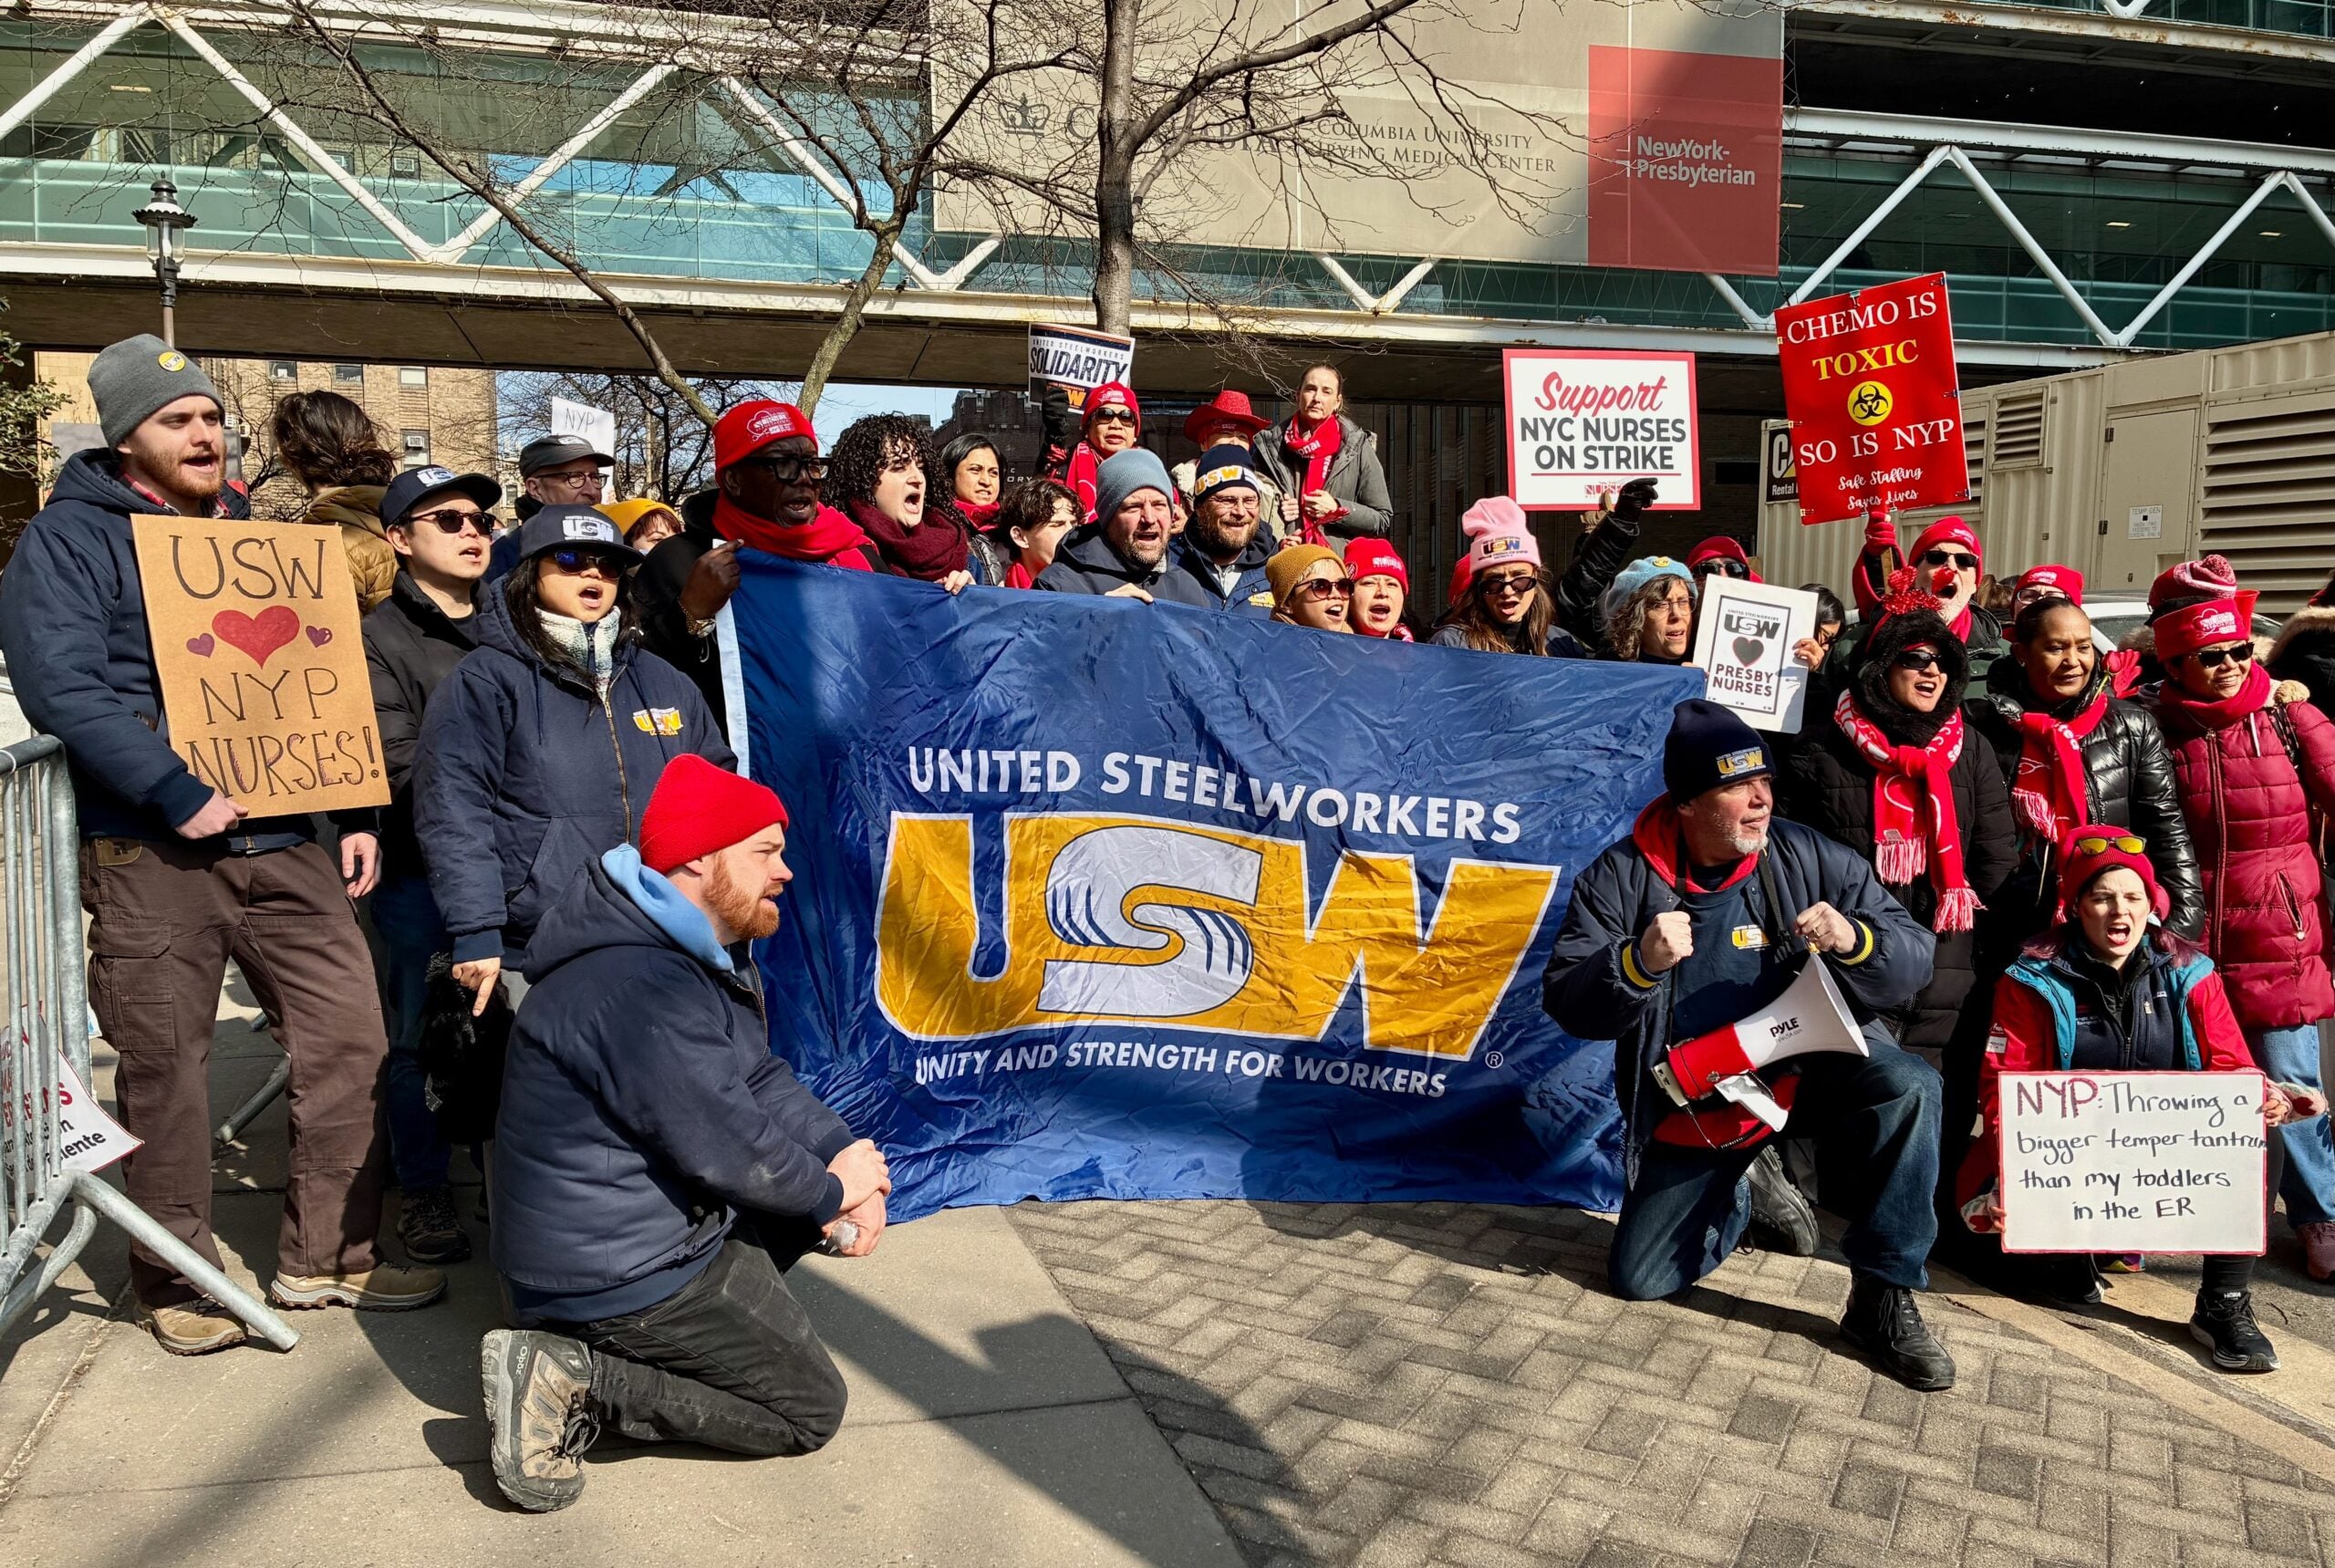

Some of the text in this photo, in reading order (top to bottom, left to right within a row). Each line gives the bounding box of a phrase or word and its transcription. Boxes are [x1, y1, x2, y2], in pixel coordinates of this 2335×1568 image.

[1317, 119, 1533, 149] COLUMBIA UNIVERSITY
[1637, 136, 1730, 161] NewYork-
[1318, 141, 1556, 172] IRVING MEDICAL CENTER
[1637, 159, 1756, 188] Presbyterian
[1787, 291, 1937, 344] CHEMO IS
[1030, 347, 1129, 385] SOLIDARITY
[1812, 339, 1919, 380] TOXIC
[1534, 371, 1667, 418] Support
[565, 408, 595, 433] NYP
[1520, 417, 1686, 443] NYC NURSES
[1534, 445, 1675, 471] ON STRIKE
[1800, 419, 1955, 467] SO IS NYP
[1195, 465, 1243, 496] USW
[1771, 482, 1794, 496] Rental
[1838, 466, 1924, 491] Safe Staffing
[1884, 488, 1919, 504] Lives
[169, 535, 327, 600] USW
[1724, 613, 1781, 640] USW
[1712, 676, 1773, 697] NURSES
[1715, 663, 1774, 684] PRESBY
[199, 667, 338, 725] NYP
[185, 726, 380, 798] NURSES!
[1717, 750, 1764, 774] USW
[909, 745, 1521, 845] UNITED STEELWORKERS
[873, 810, 1562, 1063] USW
[1769, 1017, 1800, 1038] PYLE
[915, 1041, 1447, 1098] UNITY AND STRENGTH FOR WORKERS
[2101, 1081, 2226, 1127] Throwing
[2233, 1094, 2249, 1106] a
[2017, 1130, 2099, 1165] bigger
[2105, 1127, 2185, 1158] temper
[2018, 1168, 2232, 1197] than my toddlers
[2072, 1196, 2196, 1220] in the ER
